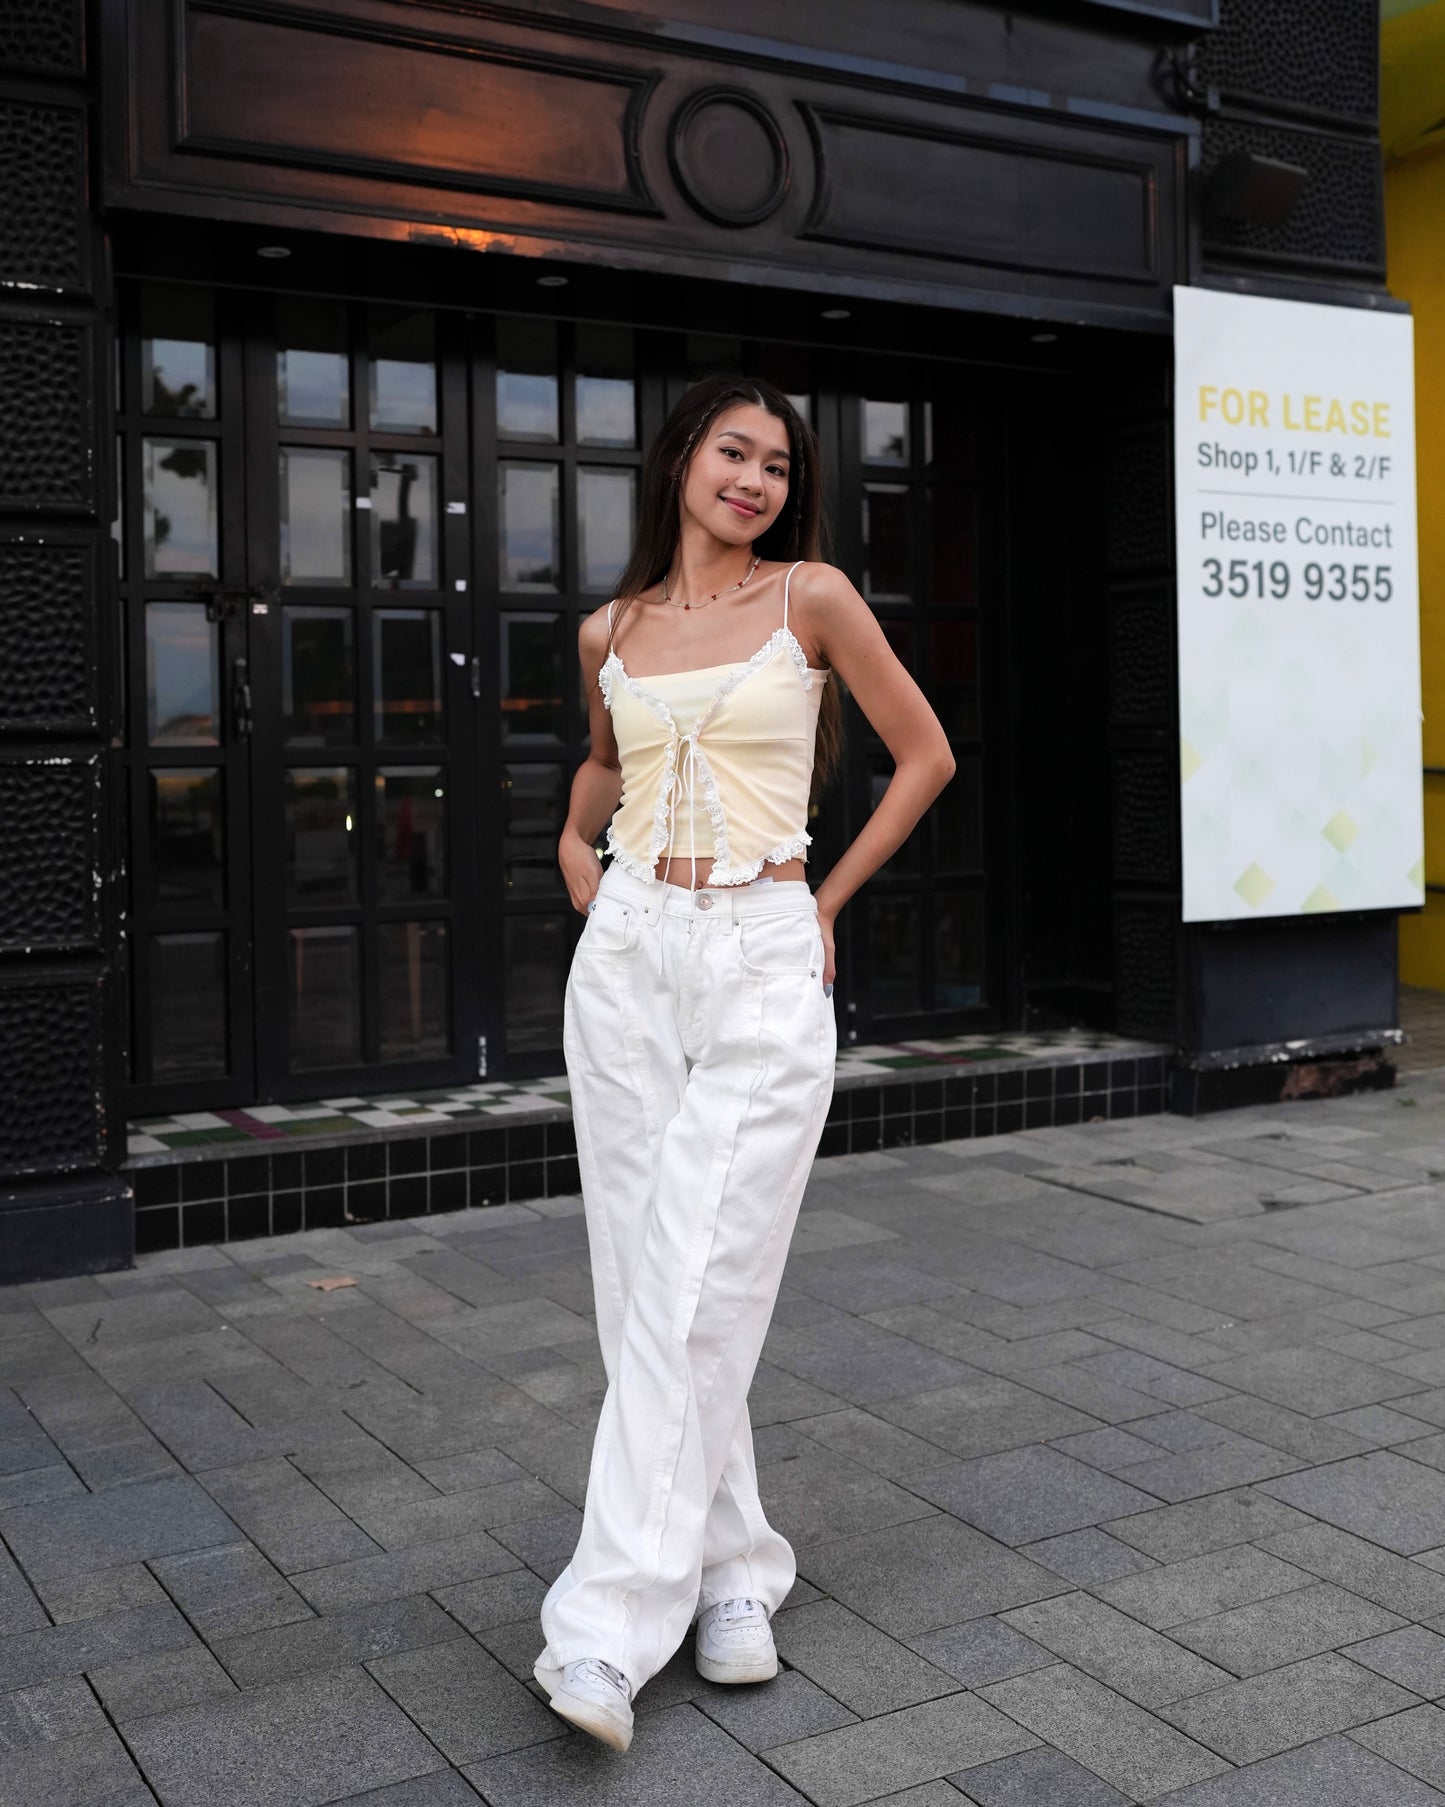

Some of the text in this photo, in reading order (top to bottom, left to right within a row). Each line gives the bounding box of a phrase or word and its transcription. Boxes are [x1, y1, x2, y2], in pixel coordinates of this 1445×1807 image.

[1198, 385, 1391, 438] FOR LEASE
[1197, 441, 1391, 479] Shop 1, 1/F & 2/F
[1201, 511, 1392, 549] Please Contact
[1201, 557, 1394, 604] 3519 9355
